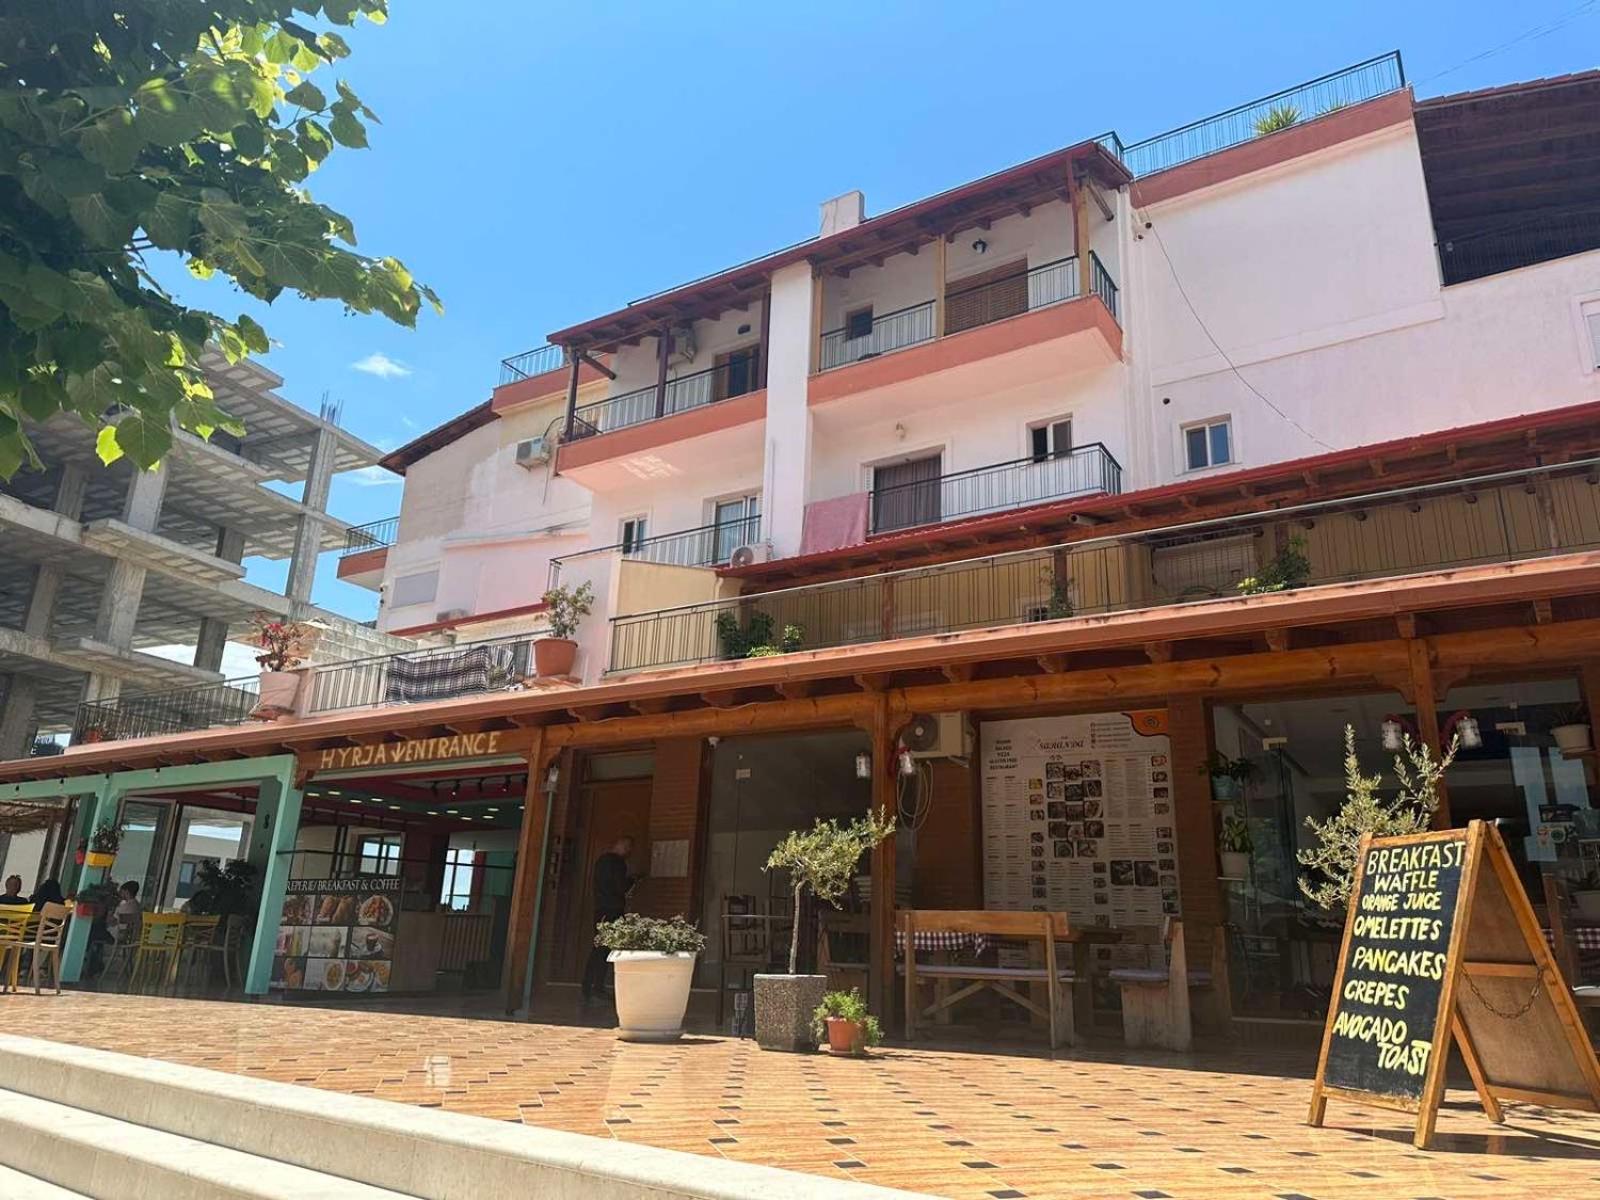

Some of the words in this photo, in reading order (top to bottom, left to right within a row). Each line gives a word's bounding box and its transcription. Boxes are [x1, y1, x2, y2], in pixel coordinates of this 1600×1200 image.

[321, 744, 386, 769] HYRJA
[405, 731, 500, 762] ENTRANCE
[1366, 841, 1466, 875] BREAKFAST
[286, 880, 318, 892] REPERIE/
[1374, 870, 1440, 894] WAFFLE
[1361, 894, 1400, 912] ORANGE
[1402, 891, 1443, 911] JUICE
[1353, 915, 1443, 941] OMELETTES
[1352, 946, 1446, 980] PANCAKES
[1343, 979, 1410, 1010] CREPES
[1332, 1011, 1407, 1044] AVOCADO
[1377, 1039, 1433, 1076] TOAST
